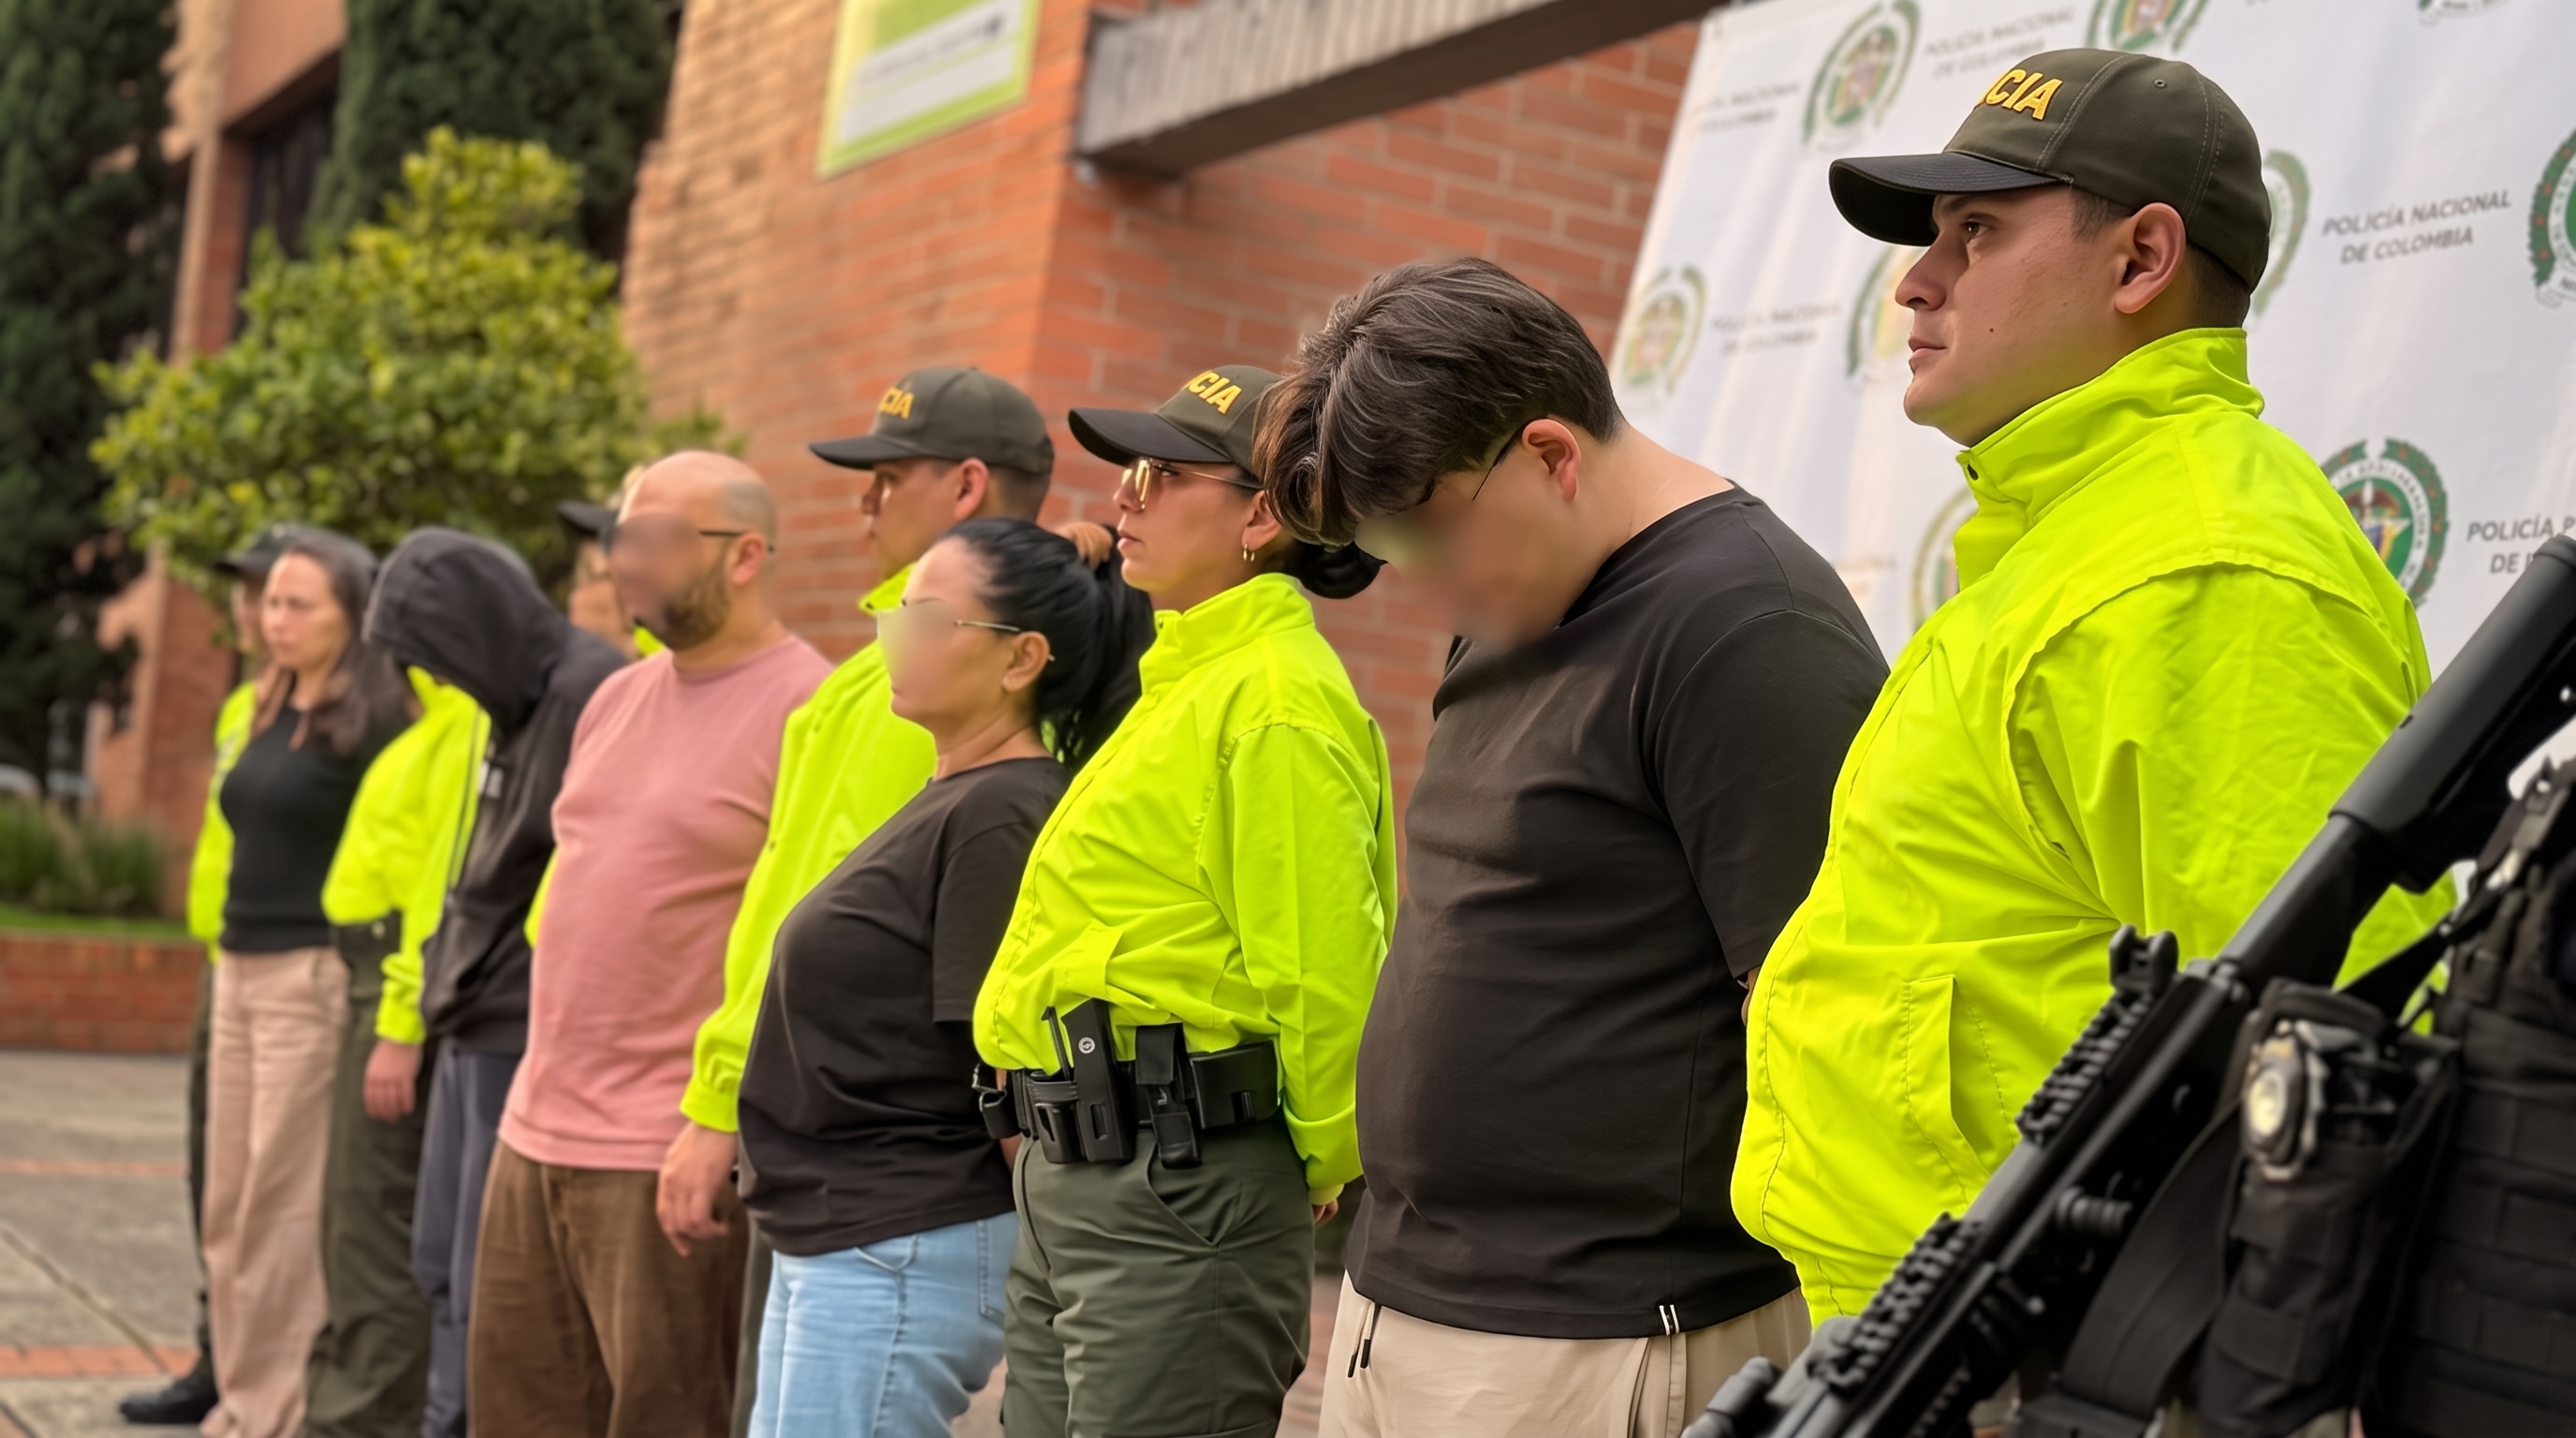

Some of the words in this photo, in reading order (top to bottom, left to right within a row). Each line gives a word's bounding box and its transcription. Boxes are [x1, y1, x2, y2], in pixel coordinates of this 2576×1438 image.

[1976, 68, 2063, 121] CIA
[2322, 203, 2404, 237] POLICÍA
[2411, 190, 2510, 225] NACIONAL
[2341, 242, 2369, 264] DE
[2375, 226, 2473, 259] COLOMBIA
[1182, 370, 1242, 414] CIA
[2466, 513, 2554, 541] POLICÍA
[2491, 552, 2520, 574] DE
